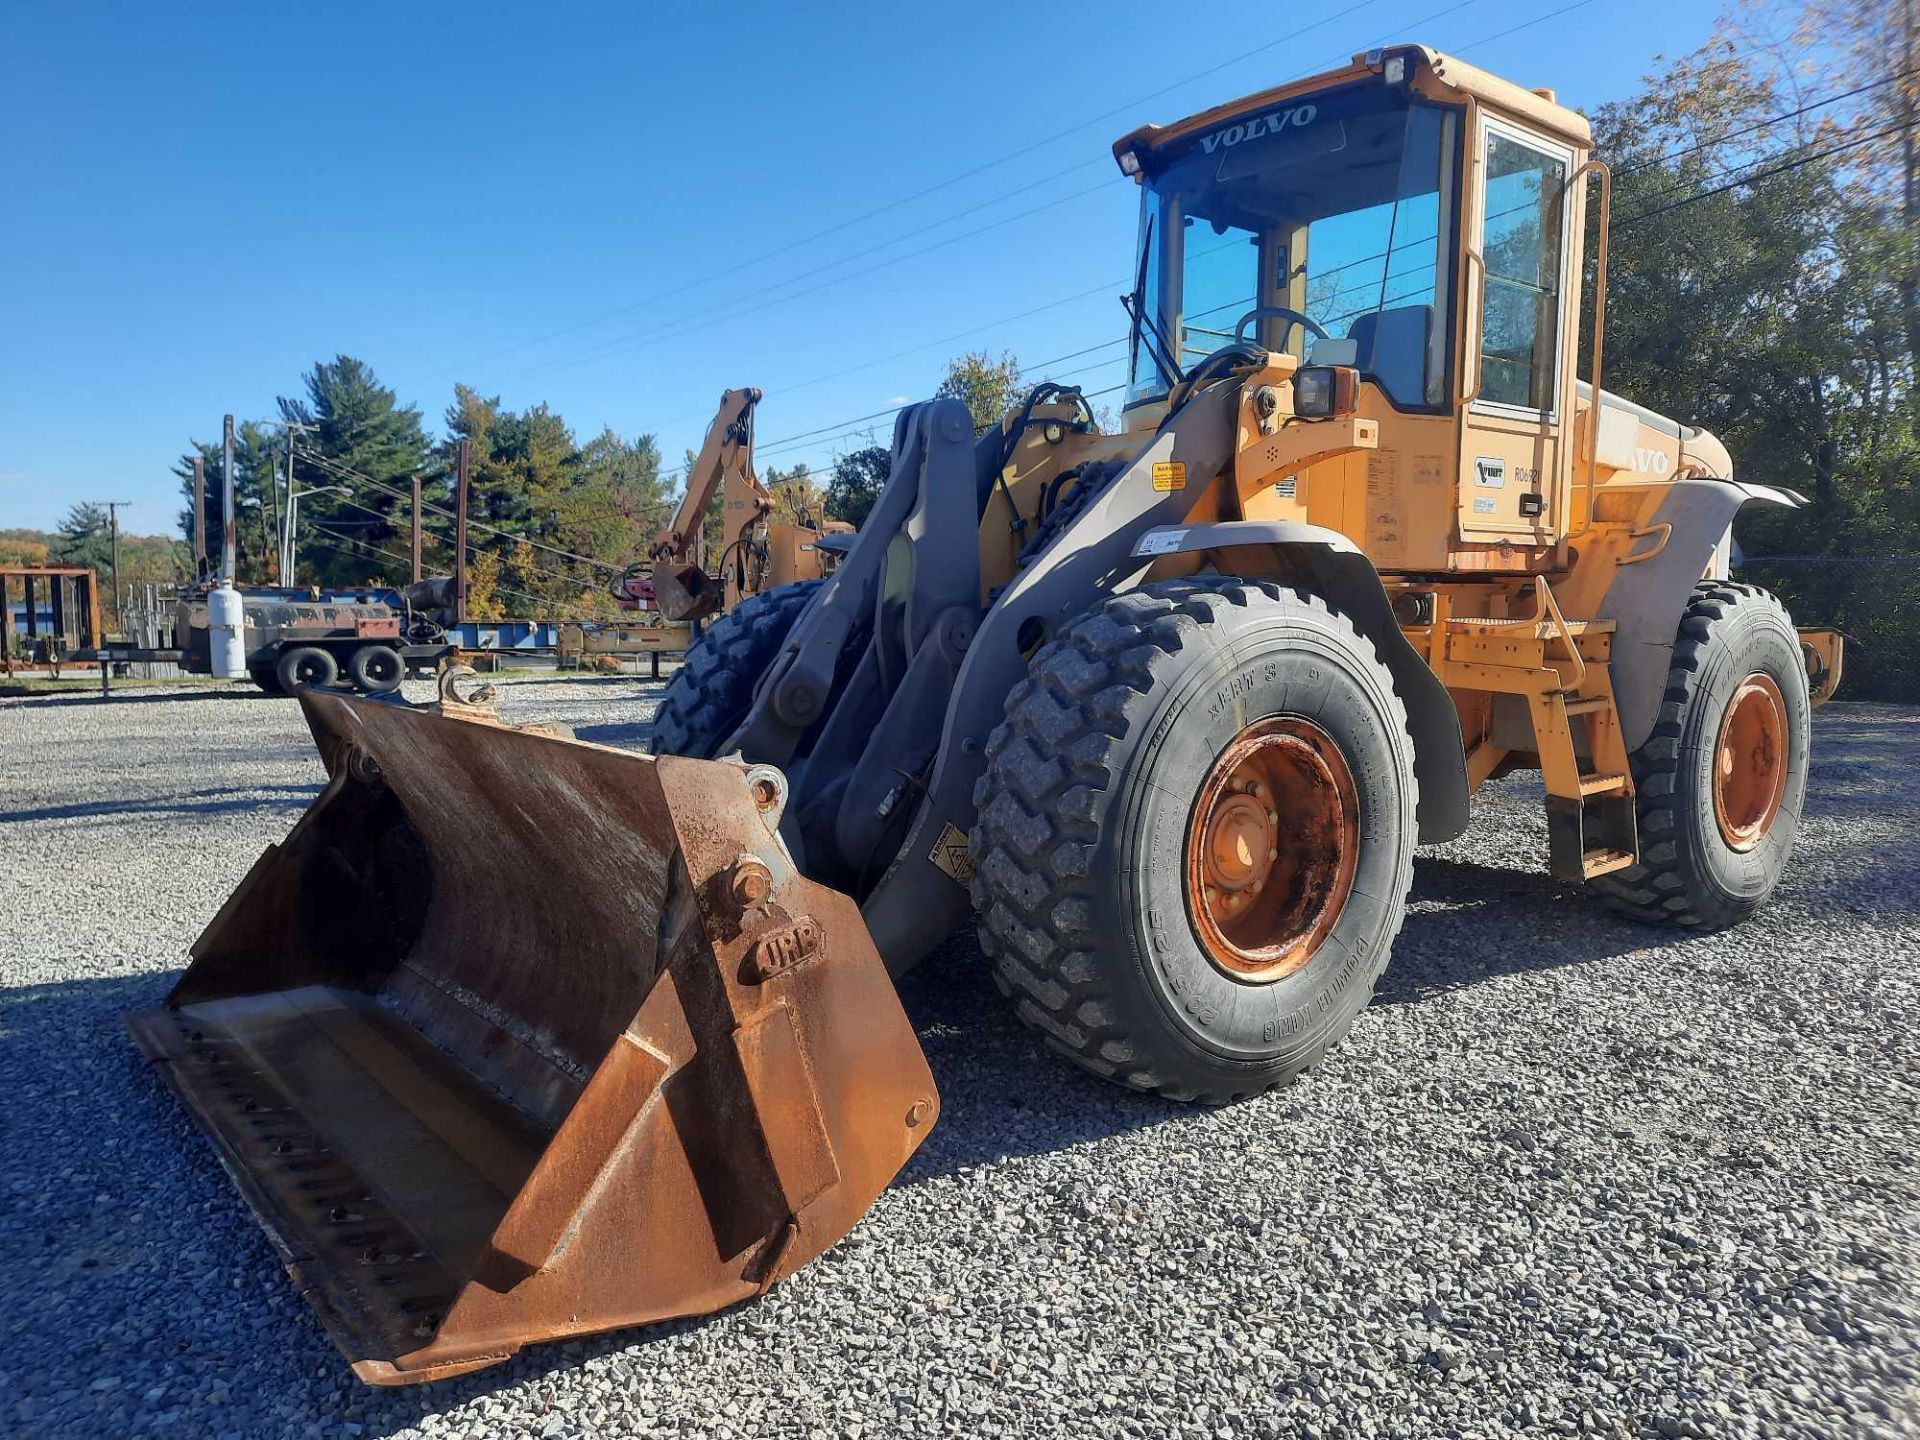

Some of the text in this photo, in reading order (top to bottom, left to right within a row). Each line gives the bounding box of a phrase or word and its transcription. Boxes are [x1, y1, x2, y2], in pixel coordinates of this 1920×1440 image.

[1199, 104, 1318, 155] VOLVO
[1514, 467, 1541, 484] R06921
[1263, 1003, 1313, 1043] KING
